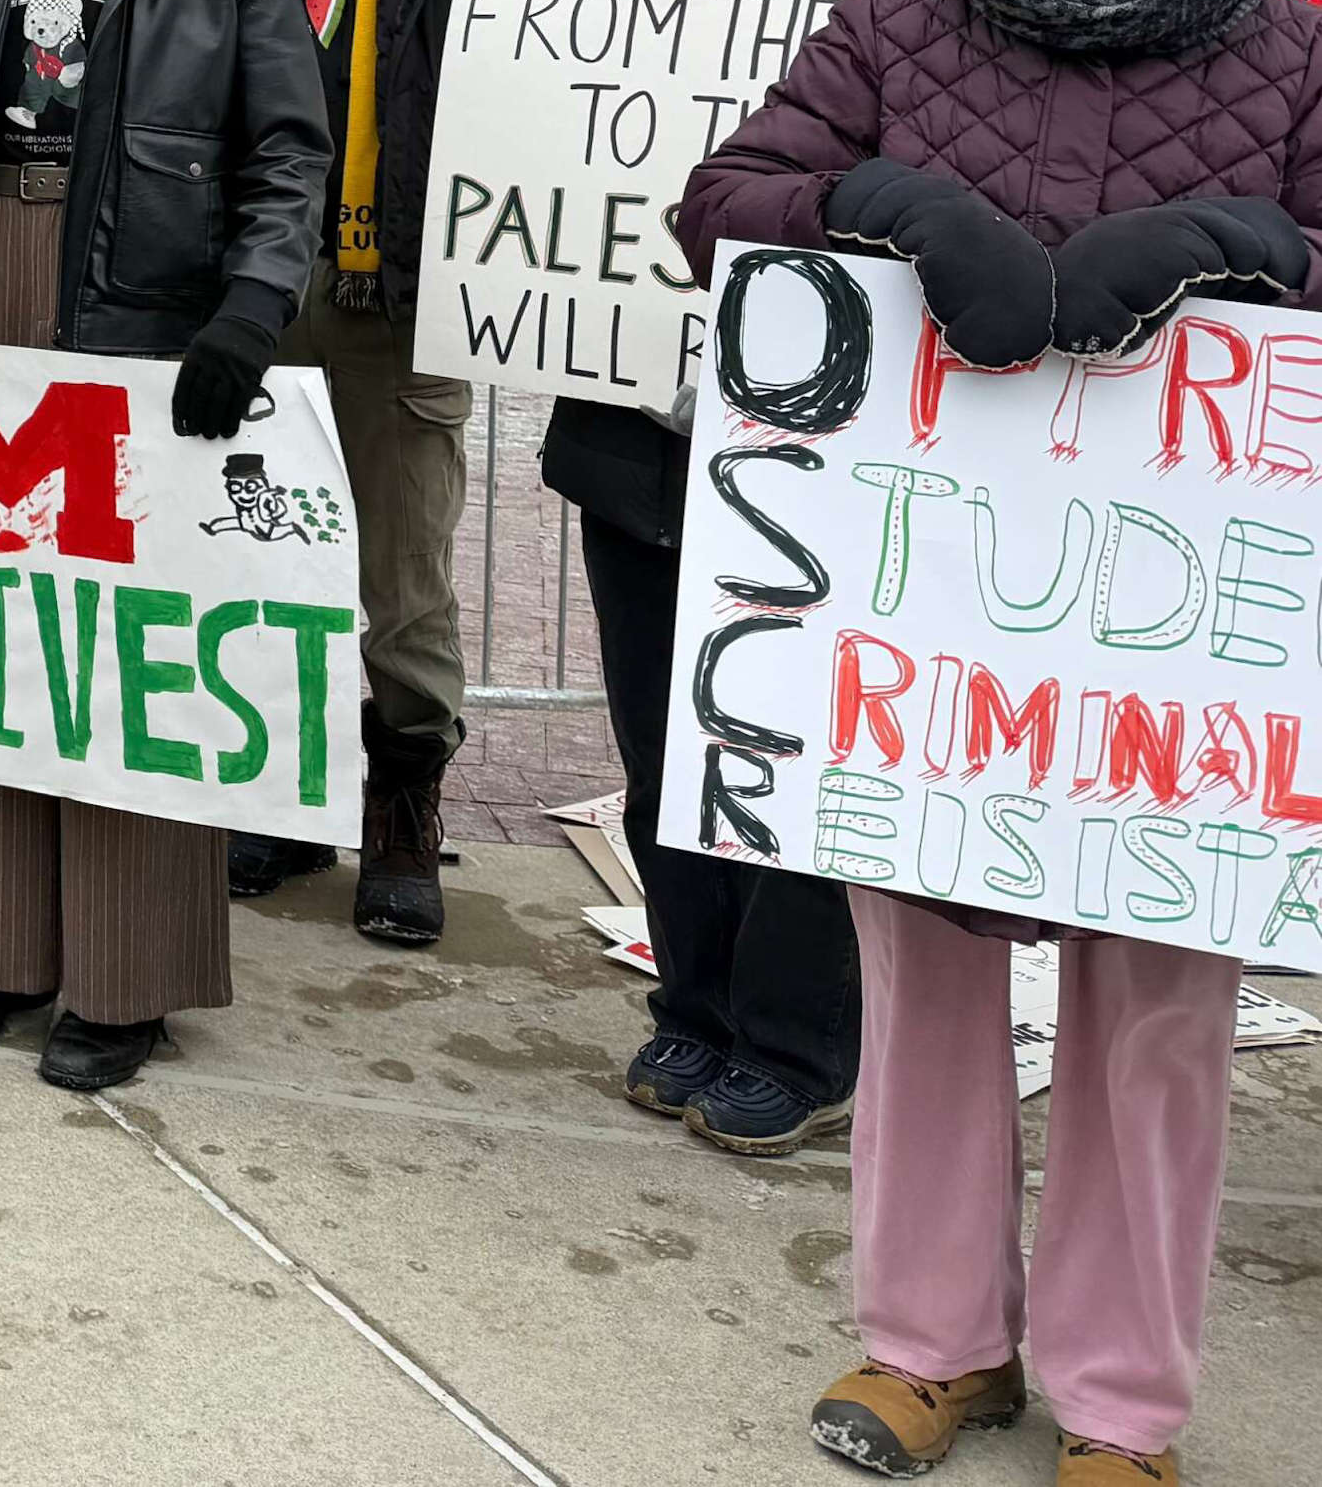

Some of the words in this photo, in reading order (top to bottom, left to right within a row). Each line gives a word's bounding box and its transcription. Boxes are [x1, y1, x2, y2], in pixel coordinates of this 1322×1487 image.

[570, 83, 657, 169] TO
[692, 95, 750, 161] T
[338, 229, 380, 251] LU
[460, 282, 638, 387] WILL
[708, 443, 1322, 666] STUDE
[693, 617, 1322, 823] CRIMINAL
